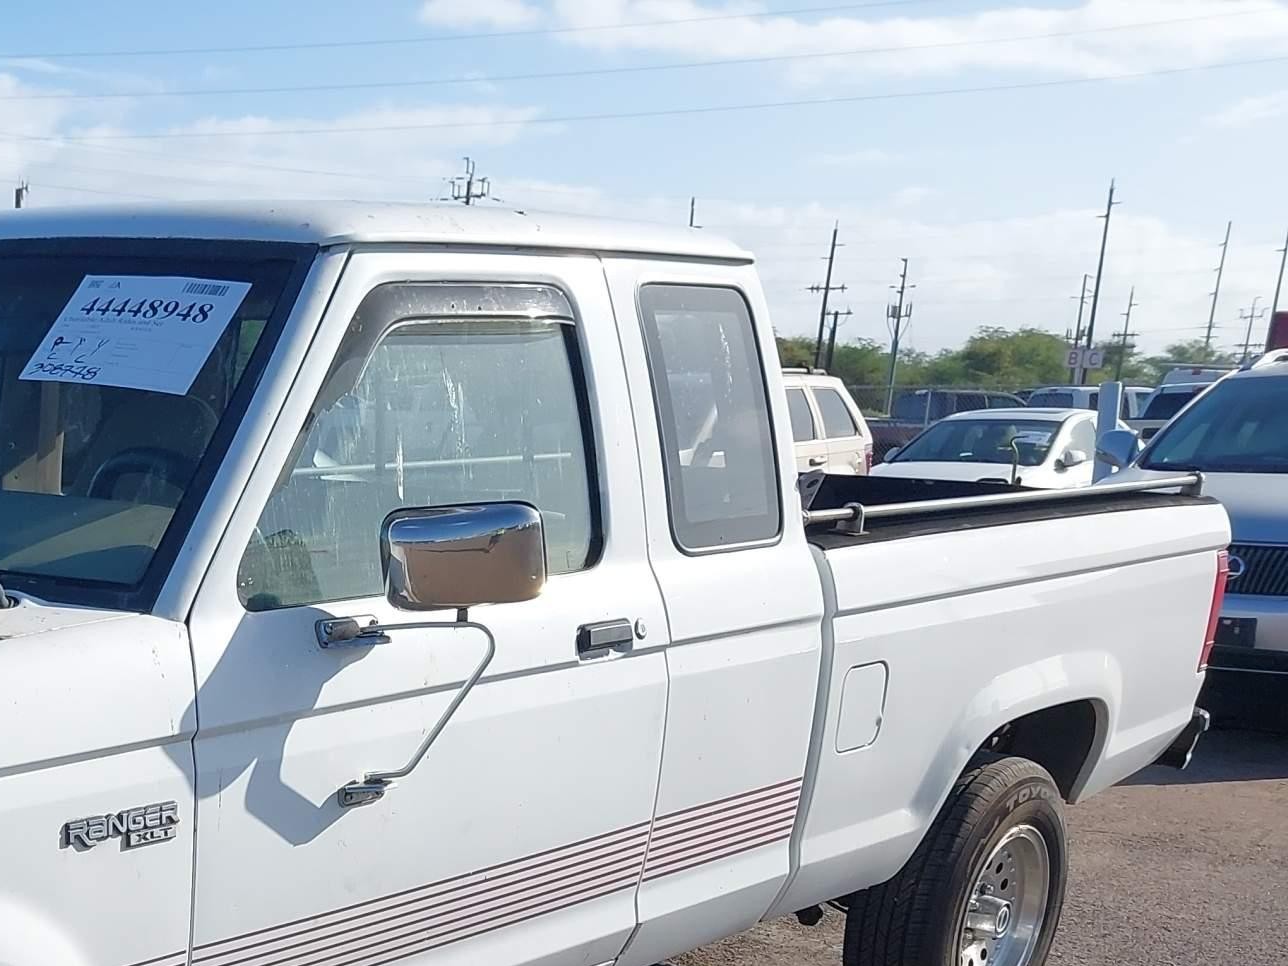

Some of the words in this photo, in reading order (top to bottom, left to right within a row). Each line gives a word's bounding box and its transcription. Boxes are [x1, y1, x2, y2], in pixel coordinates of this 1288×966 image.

[81, 297, 214, 324] 44448948
[1068, 351, 1078, 366] B
[1088, 352, 1098, 366] C
[127, 826, 176, 847] XLT
